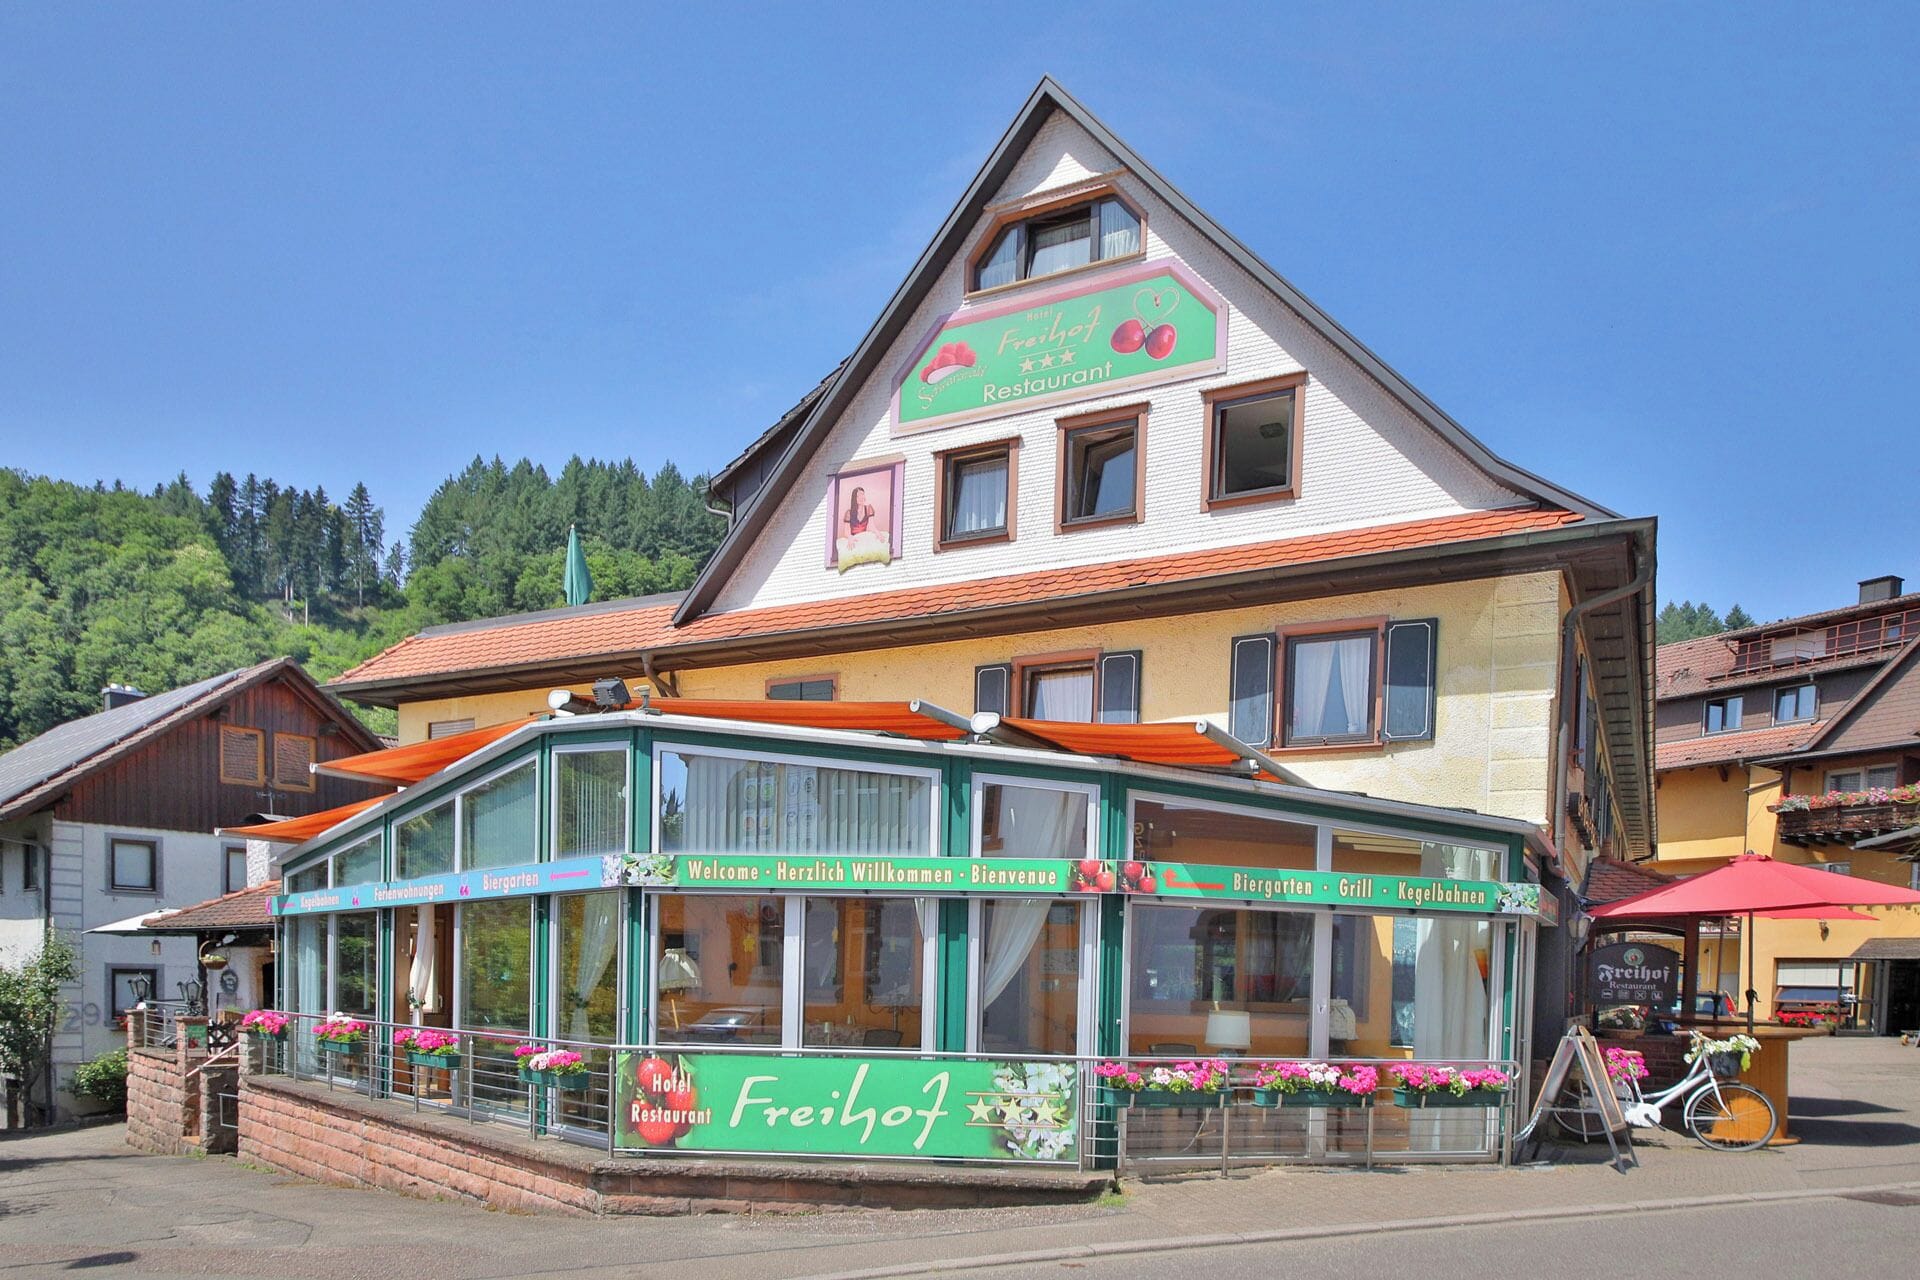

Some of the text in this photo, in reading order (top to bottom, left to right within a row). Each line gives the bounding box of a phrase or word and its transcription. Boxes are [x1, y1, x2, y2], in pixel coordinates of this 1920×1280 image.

[1026, 305, 1054, 322] Hotel
[997, 304, 1103, 356] Freihof
[983, 360, 1113, 403] Restaurant
[373, 884, 445, 903] Ferienwohnungen
[482, 869, 540, 892] Biergarten
[687, 859, 1058, 886] Welcome Herzlich Willkommen Bienvenue
[1232, 872, 1486, 906] Biergarten Grill Kegelbahnen
[1598, 964, 1671, 983] Freihof
[1609, 980, 1657, 991] Restaurant
[651, 1071, 692, 1094] Hotel
[631, 1104, 712, 1126] Restaurant
[729, 1062, 950, 1150] Freihof
